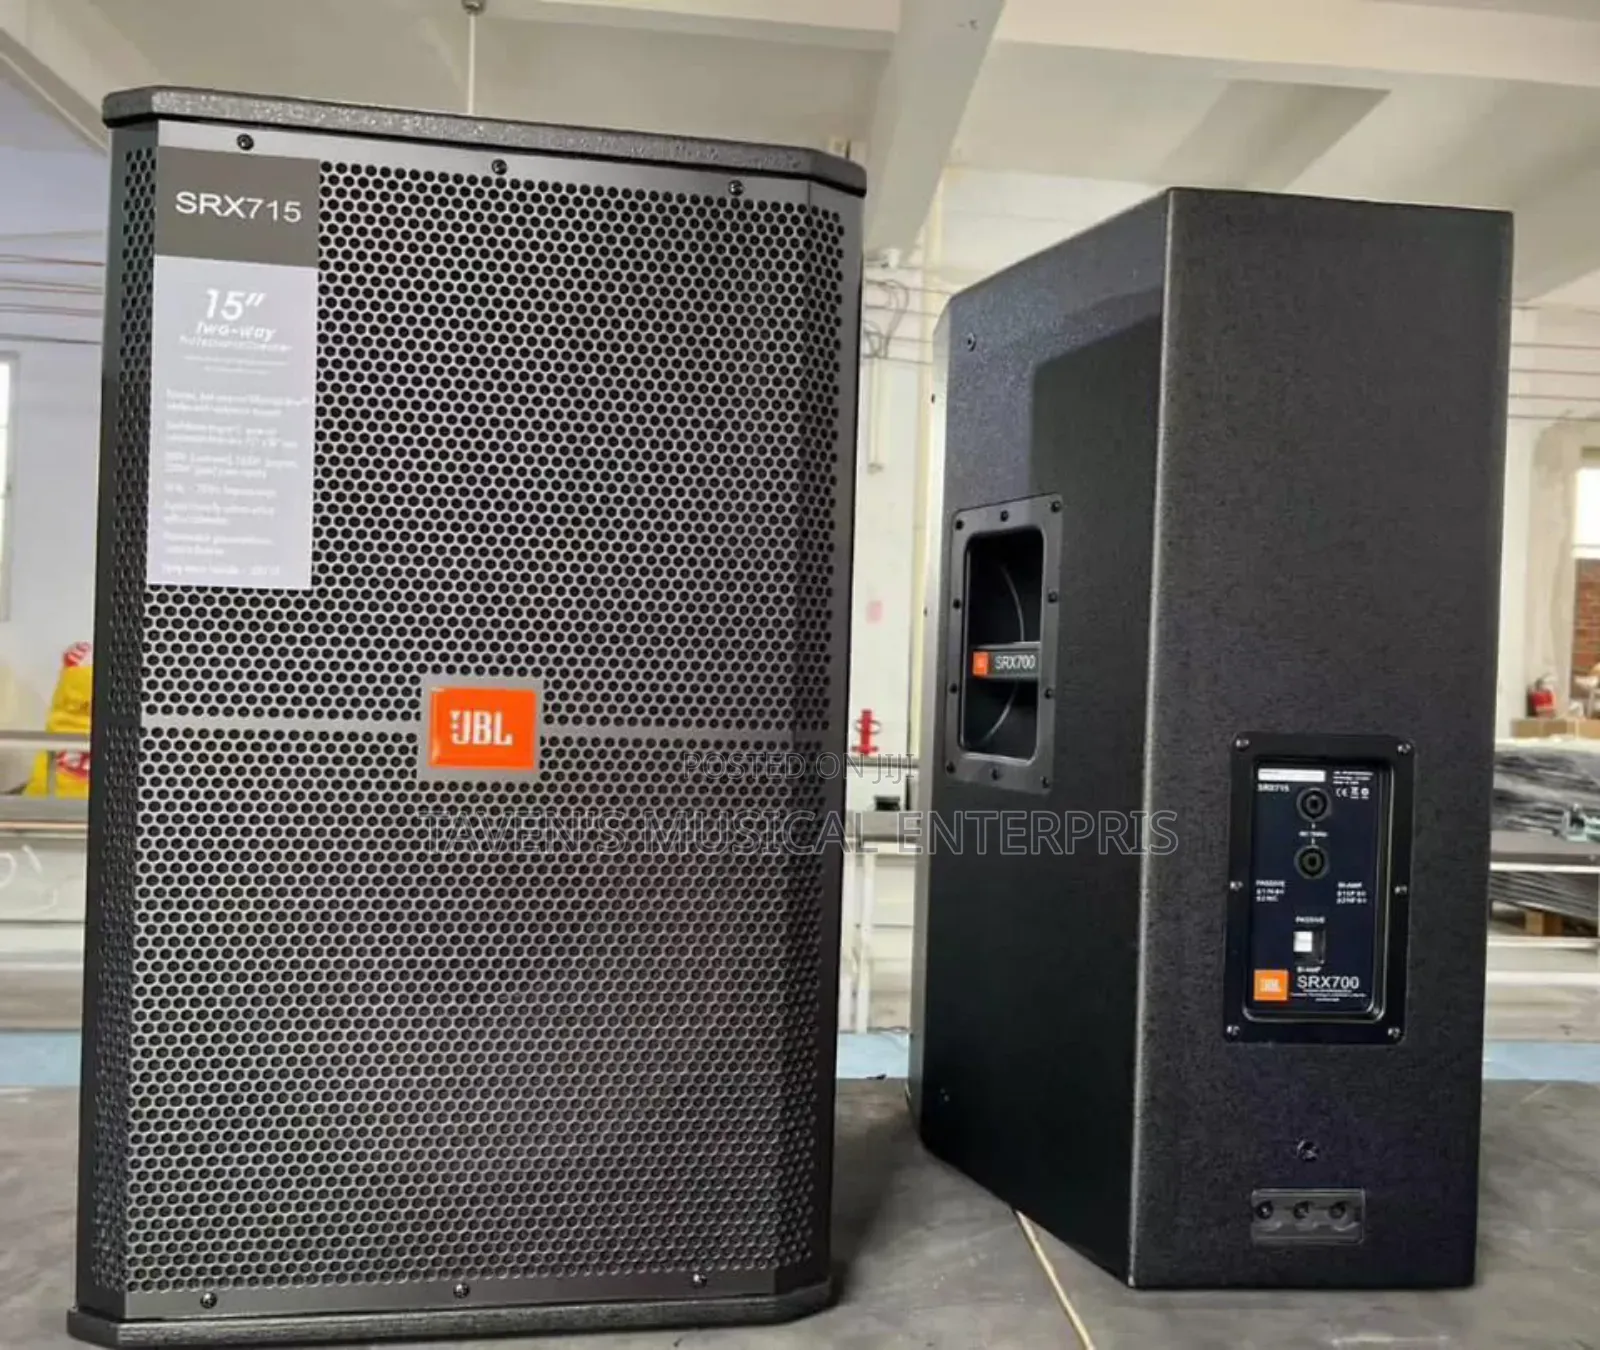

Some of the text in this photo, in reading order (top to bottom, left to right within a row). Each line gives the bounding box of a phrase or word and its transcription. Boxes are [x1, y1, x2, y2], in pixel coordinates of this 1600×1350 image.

[175, 190, 302, 223] SRX715
[994, 654, 1037, 670] SRX700
[450, 709, 513, 746] JBL
[1297, 975, 1360, 990] SRX700
